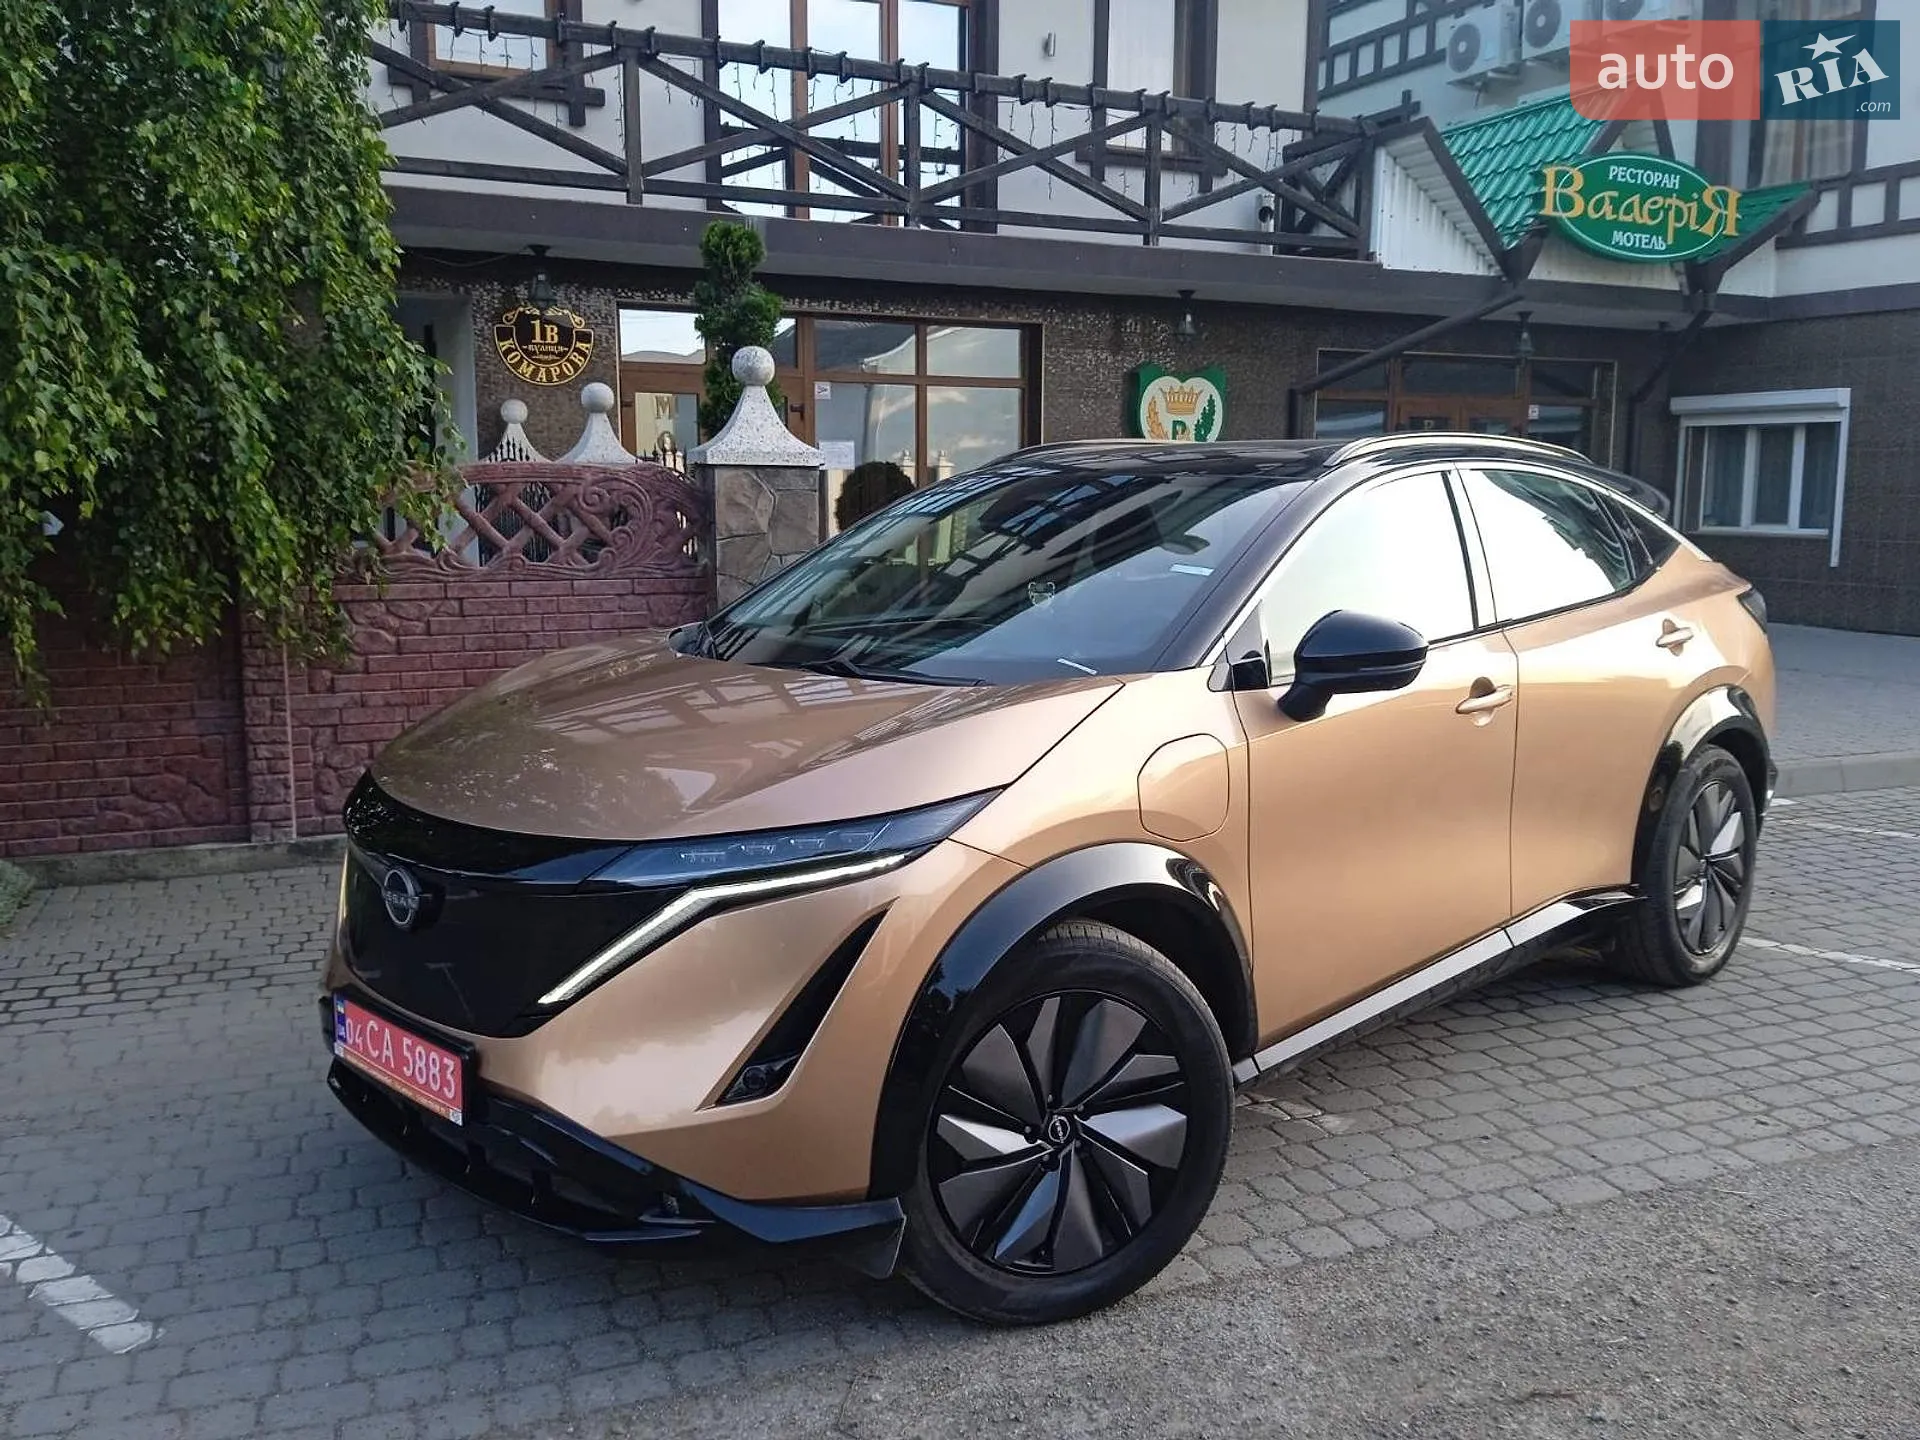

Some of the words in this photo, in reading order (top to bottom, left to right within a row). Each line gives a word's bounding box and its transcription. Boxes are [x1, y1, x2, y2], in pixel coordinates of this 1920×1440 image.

[1608, 165, 1681, 190] РЕСТОРАН
[1611, 230, 1667, 251] МОТЕЛЬ
[499, 338, 592, 384] КОМАРОВА
[402, 1036, 456, 1099] 5883
